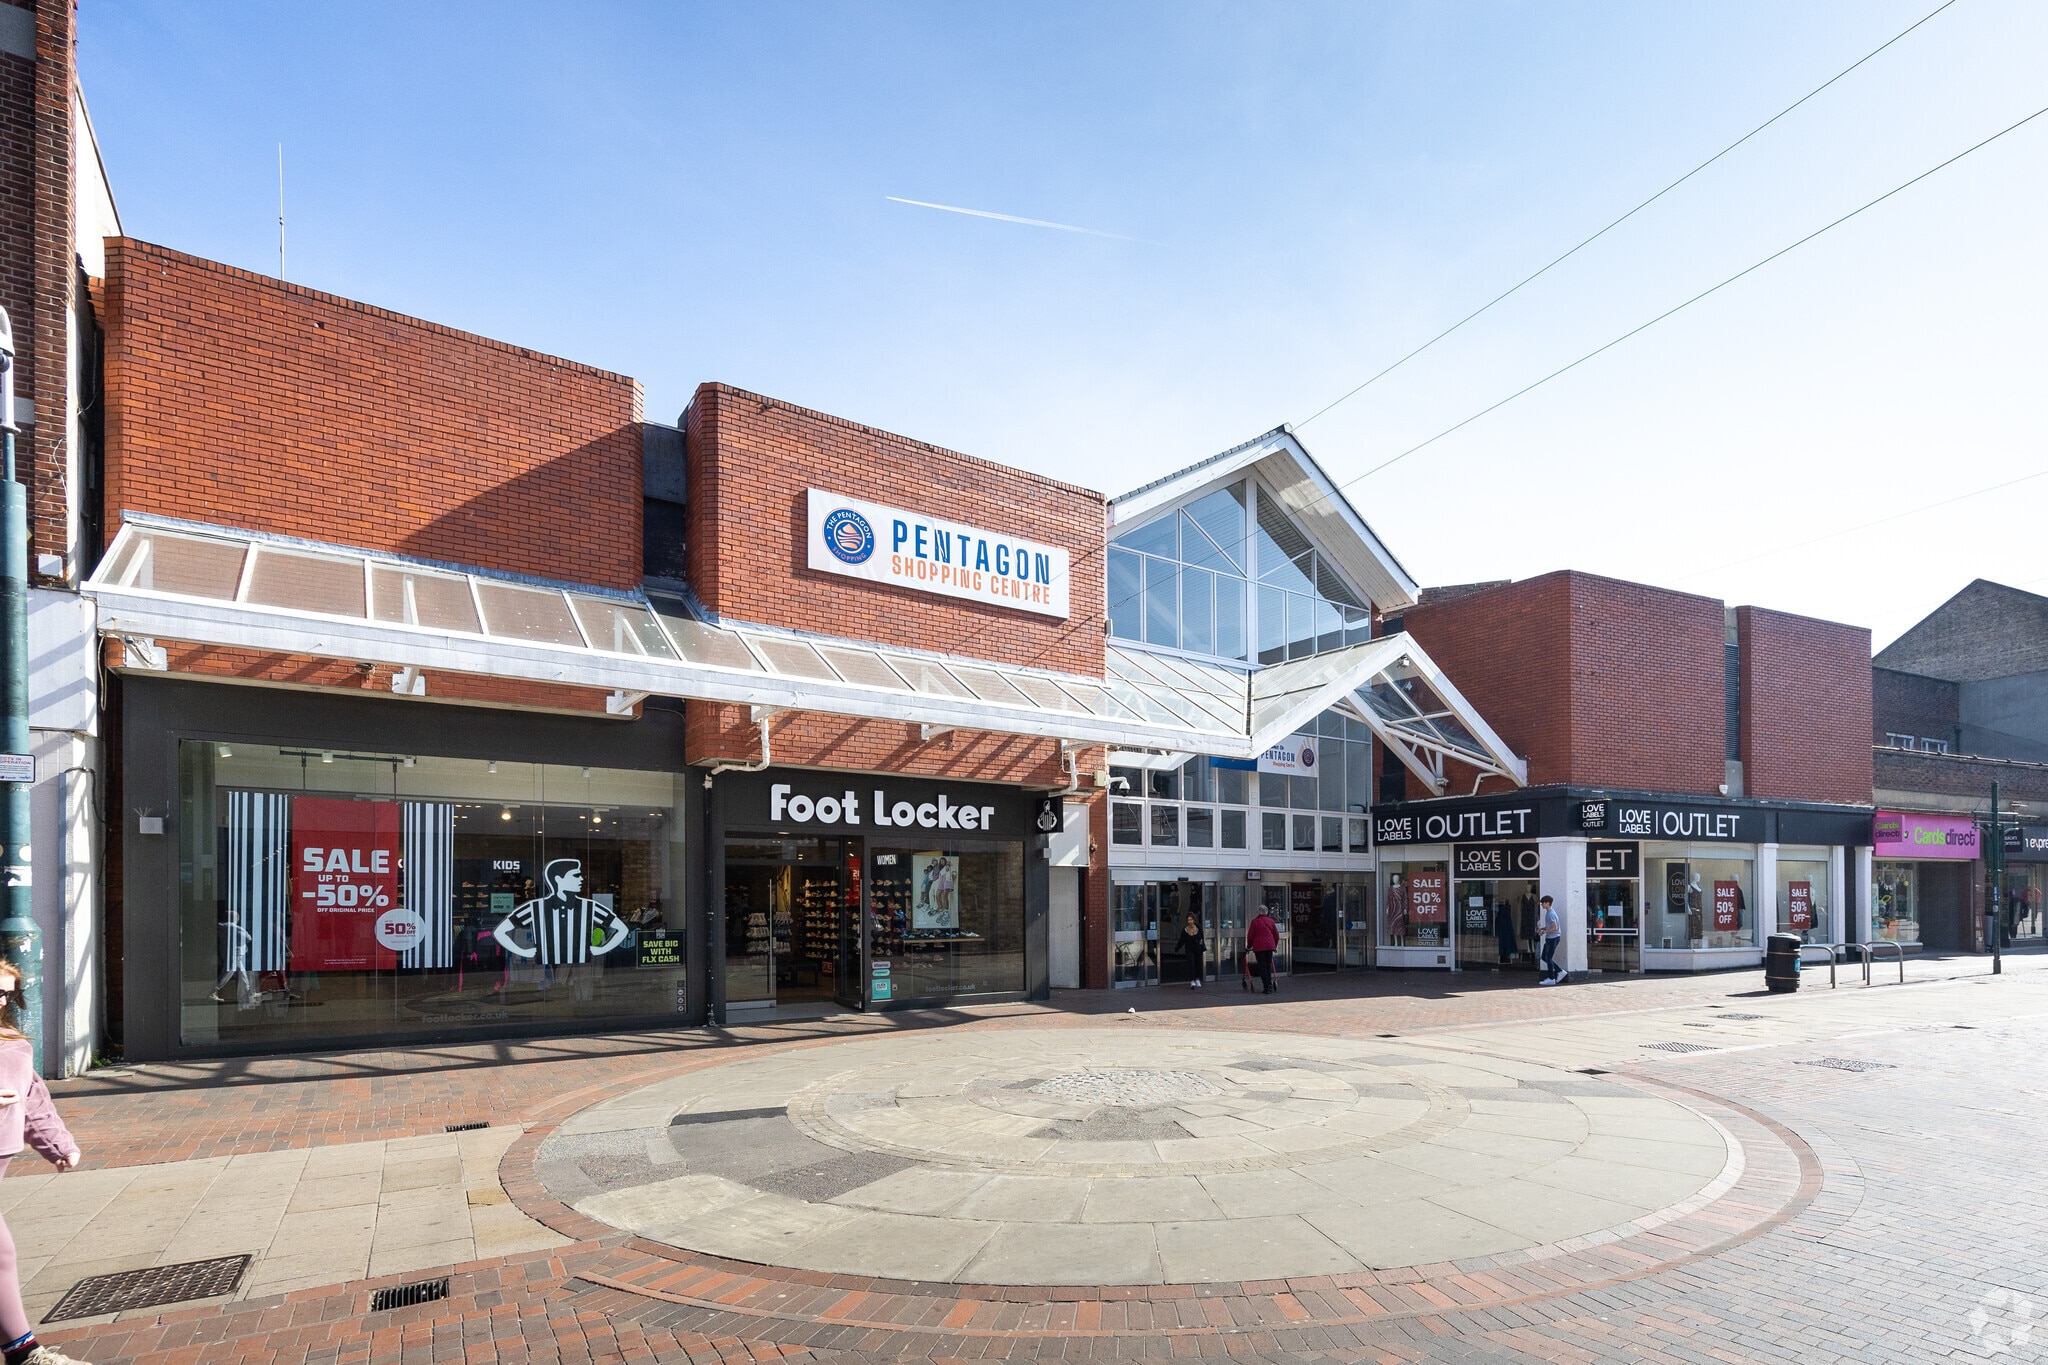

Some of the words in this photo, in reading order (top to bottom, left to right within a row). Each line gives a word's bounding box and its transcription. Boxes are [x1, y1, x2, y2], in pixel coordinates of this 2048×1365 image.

[827, 516, 838, 530] THE
[837, 511, 872, 539] PENTAGON
[832, 546, 867, 562] SHOPPING
[893, 519, 1050, 585] PENTAGON
[892, 554, 982, 593] SHOPPING
[990, 575, 1050, 605] CENTRE
[1261, 750, 1294, 762] PENTAGON
[771, 783, 860, 825] Foot
[874, 790, 995, 831] Locker
[1582, 803, 1605, 813] LOVE
[1582, 811, 1605, 819] LABELS
[1619, 808, 1651, 824] LOVE
[1377, 817, 1412, 832] LOVE
[1425, 808, 1532, 838] OUTLET
[1582, 820, 1605, 828] OUTLET
[1619, 823, 1651, 834] LABELS
[1662, 811, 1741, 838] OUTLET
[1875, 822, 1900, 830] Cards
[1377, 830, 1412, 842] LABELS
[1875, 830, 1901, 838] direct
[1914, 826, 1976, 847] Cardsdirect
[303, 847, 390, 873] SALE
[876, 854, 897, 866] WOMEN
[1460, 850, 1501, 863] LOVE
[493, 860, 520, 870] KIDS
[1460, 862, 1502, 872] LABELS
[318, 874, 333, 883] UP
[335, 874, 349, 883] TO
[1413, 879, 1441, 888] SALE
[302, 884, 390, 907] -50%
[1292, 891, 1312, 900] SALE
[1413, 892, 1441, 904] 50%
[1716, 888, 1735, 897] SALE
[1791, 888, 1808, 897] SALE
[1293, 903, 1312, 914] 50%
[1417, 905, 1438, 915] OFF
[1716, 901, 1734, 913] 50%
[1791, 901, 1807, 913] 50%
[1295, 914, 1310, 923] OFF
[1718, 914, 1732, 924] OFF
[1793, 914, 1806, 923] OFF
[643, 940, 664, 948] SAVE
[665, 940, 679, 948] BIG
[650, 948, 672, 956] WITH
[642, 956, 657, 964] FLX
[658, 955, 680, 963] CASH
[925, 983, 976, 993] footlocker.co.uk
[421, 1011, 508, 1024] footlocker.co.uk
